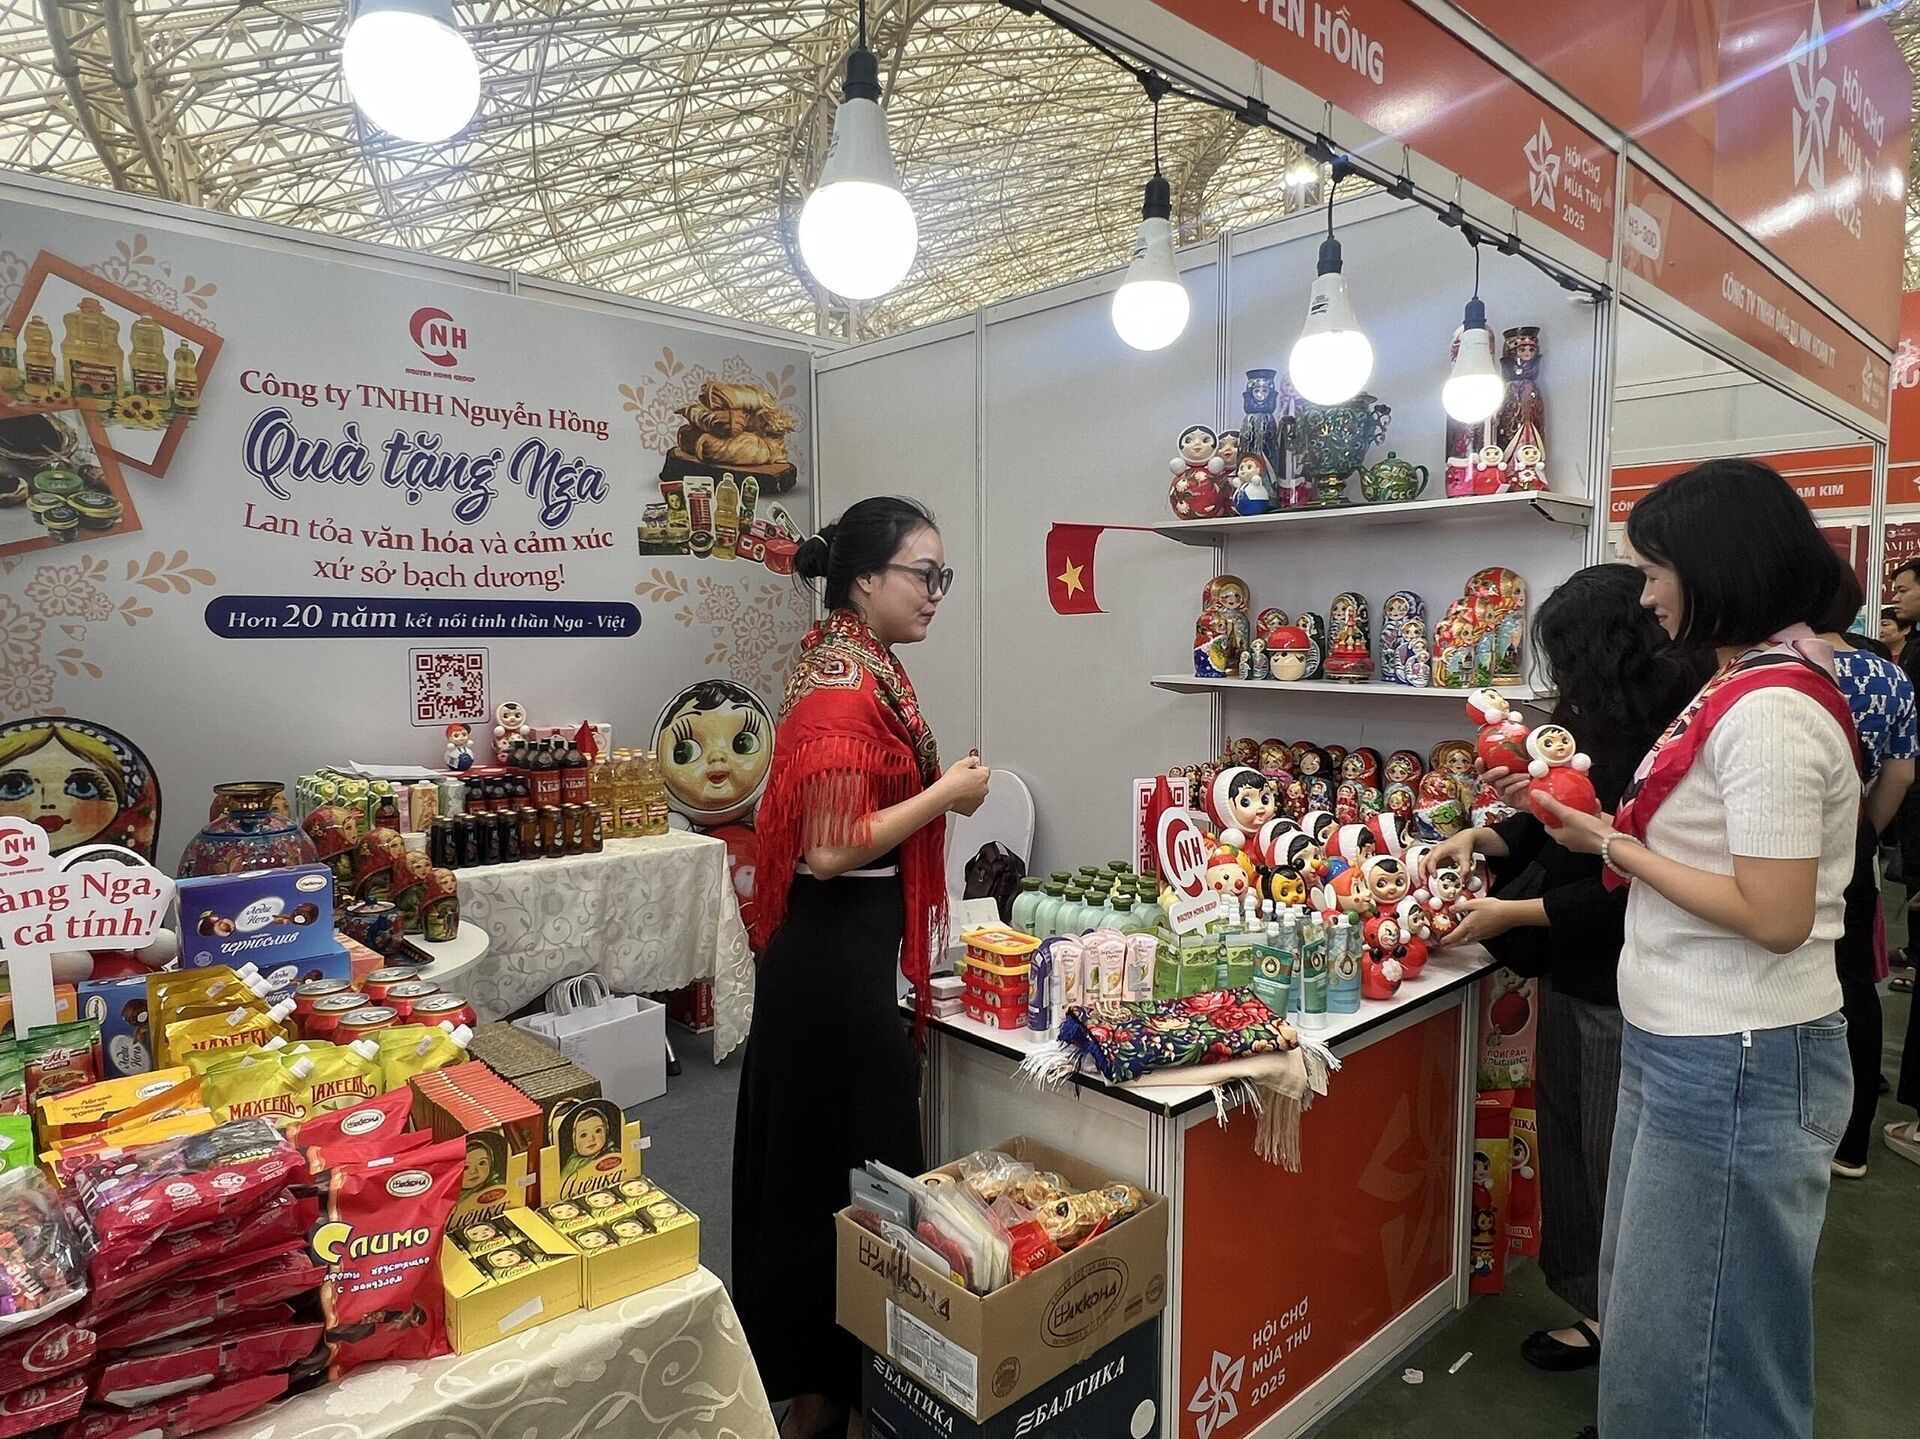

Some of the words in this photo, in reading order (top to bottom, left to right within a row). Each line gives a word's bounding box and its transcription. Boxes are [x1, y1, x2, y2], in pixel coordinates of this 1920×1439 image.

[1314, 3, 1384, 85] HỒNG
[1841, 65, 1862, 122] HỘI
[1564, 145, 1581, 172] HỘI
[1582, 158, 1601, 188] CHỢ
[1563, 174, 1584, 202] MÙA
[1585, 188, 1602, 213] THU
[1562, 203, 1585, 231] 2025
[430, 323, 467, 350] NH
[239, 370, 318, 410] Công
[325, 385, 351, 411] ty
[356, 384, 442, 416] TNHH
[450, 397, 541, 431] Nguyễn
[548, 407, 609, 440] Hồng
[242, 407, 373, 499] Quà
[382, 429, 503, 527] tặng
[508, 437, 610, 529] Nga
[1611, 501, 1635, 512] CÔN
[1795, 486, 1816, 498] AM
[1819, 484, 1844, 497] KIM
[243, 503, 300, 537] Lan
[308, 516, 353, 546] tỏa
[362, 526, 414, 551] văn
[421, 526, 475, 554] hóa
[480, 531, 508, 554] và
[514, 530, 567, 553] cảm
[571, 527, 615, 551] xúc
[312, 556, 354, 581] xứ
[360, 560, 396, 584] sở
[403, 561, 467, 592] bạch
[473, 563, 567, 592] dương!
[228, 610, 278, 628] Hơn
[282, 605, 323, 628] 20
[331, 605, 397, 628] năm
[405, 609, 435, 628] kết
[438, 610, 469, 629] nối
[471, 611, 507, 629] tinh
[510, 609, 549, 629] thần
[553, 614, 583, 633] Nga
[597, 613, 627, 631] Việt
[5, 836, 36, 855] NH
[1178, 836, 1204, 872] NH
[0, 884, 70, 914] àng
[81, 872, 162, 905] Nga,
[14, 913, 56, 946] cá
[66, 908, 158, 939] tính!
[220, 931, 300, 956] чернослив
[313, 1221, 430, 1264] Слимо
[1252, 1320, 1277, 1350] HỘI
[1280, 1296, 1309, 1330] CHỢ
[1252, 1345, 1282, 1378] MÙA
[1286, 1323, 1312, 1352] THU
[884, 1361, 954, 1433] БАЛТИКА
[1032, 1356, 1125, 1428] БАЛТИКА
[1251, 1368, 1286, 1407] 2025
